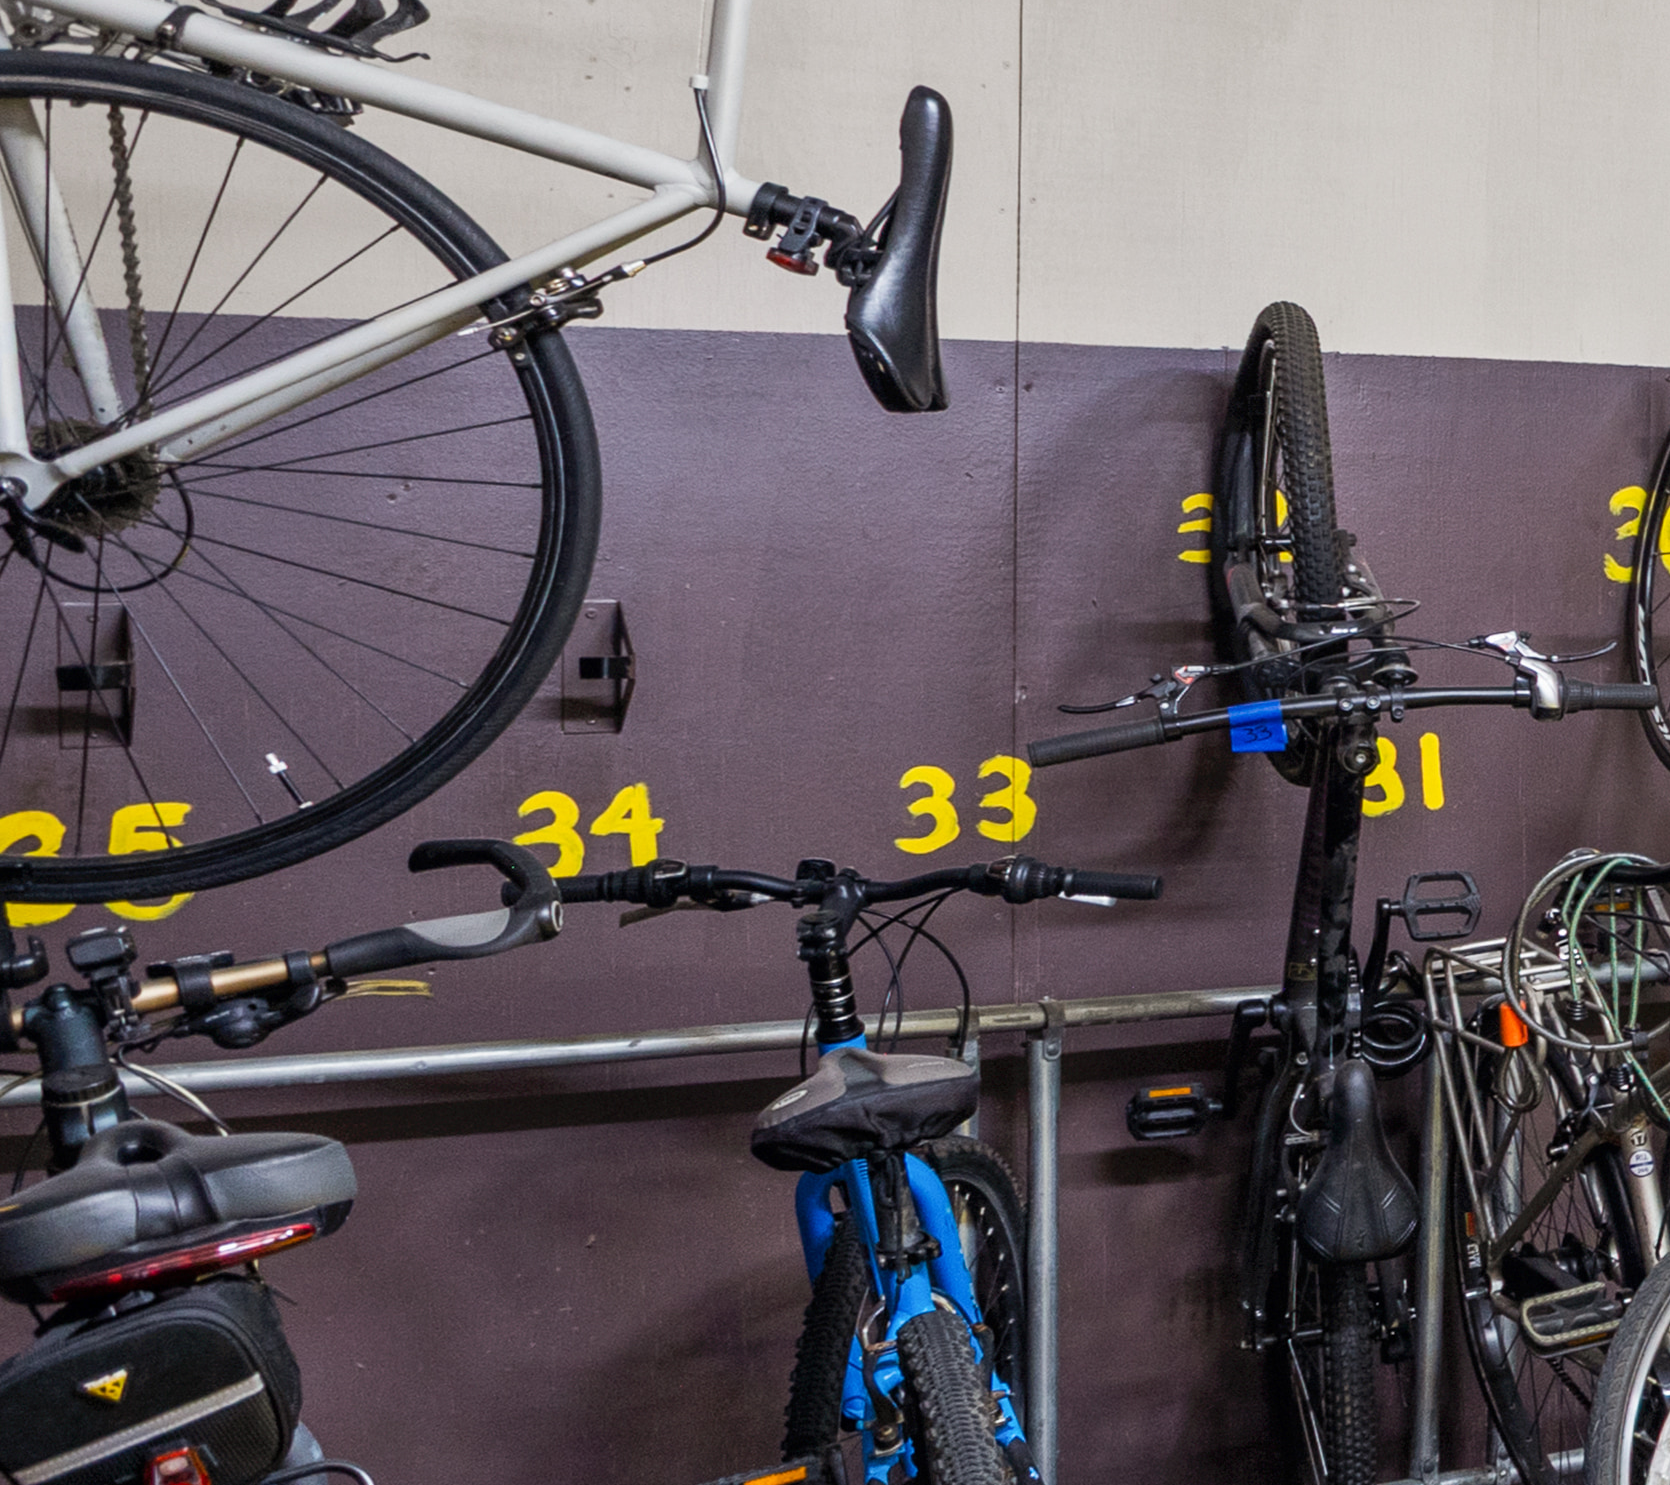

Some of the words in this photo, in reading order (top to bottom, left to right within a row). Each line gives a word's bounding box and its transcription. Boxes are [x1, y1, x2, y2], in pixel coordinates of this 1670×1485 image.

[1243, 726, 1273, 744] 33
[1360, 733, 1445, 818] 31
[510, 781, 664, 878] 34
[893, 754, 1038, 854] 33
